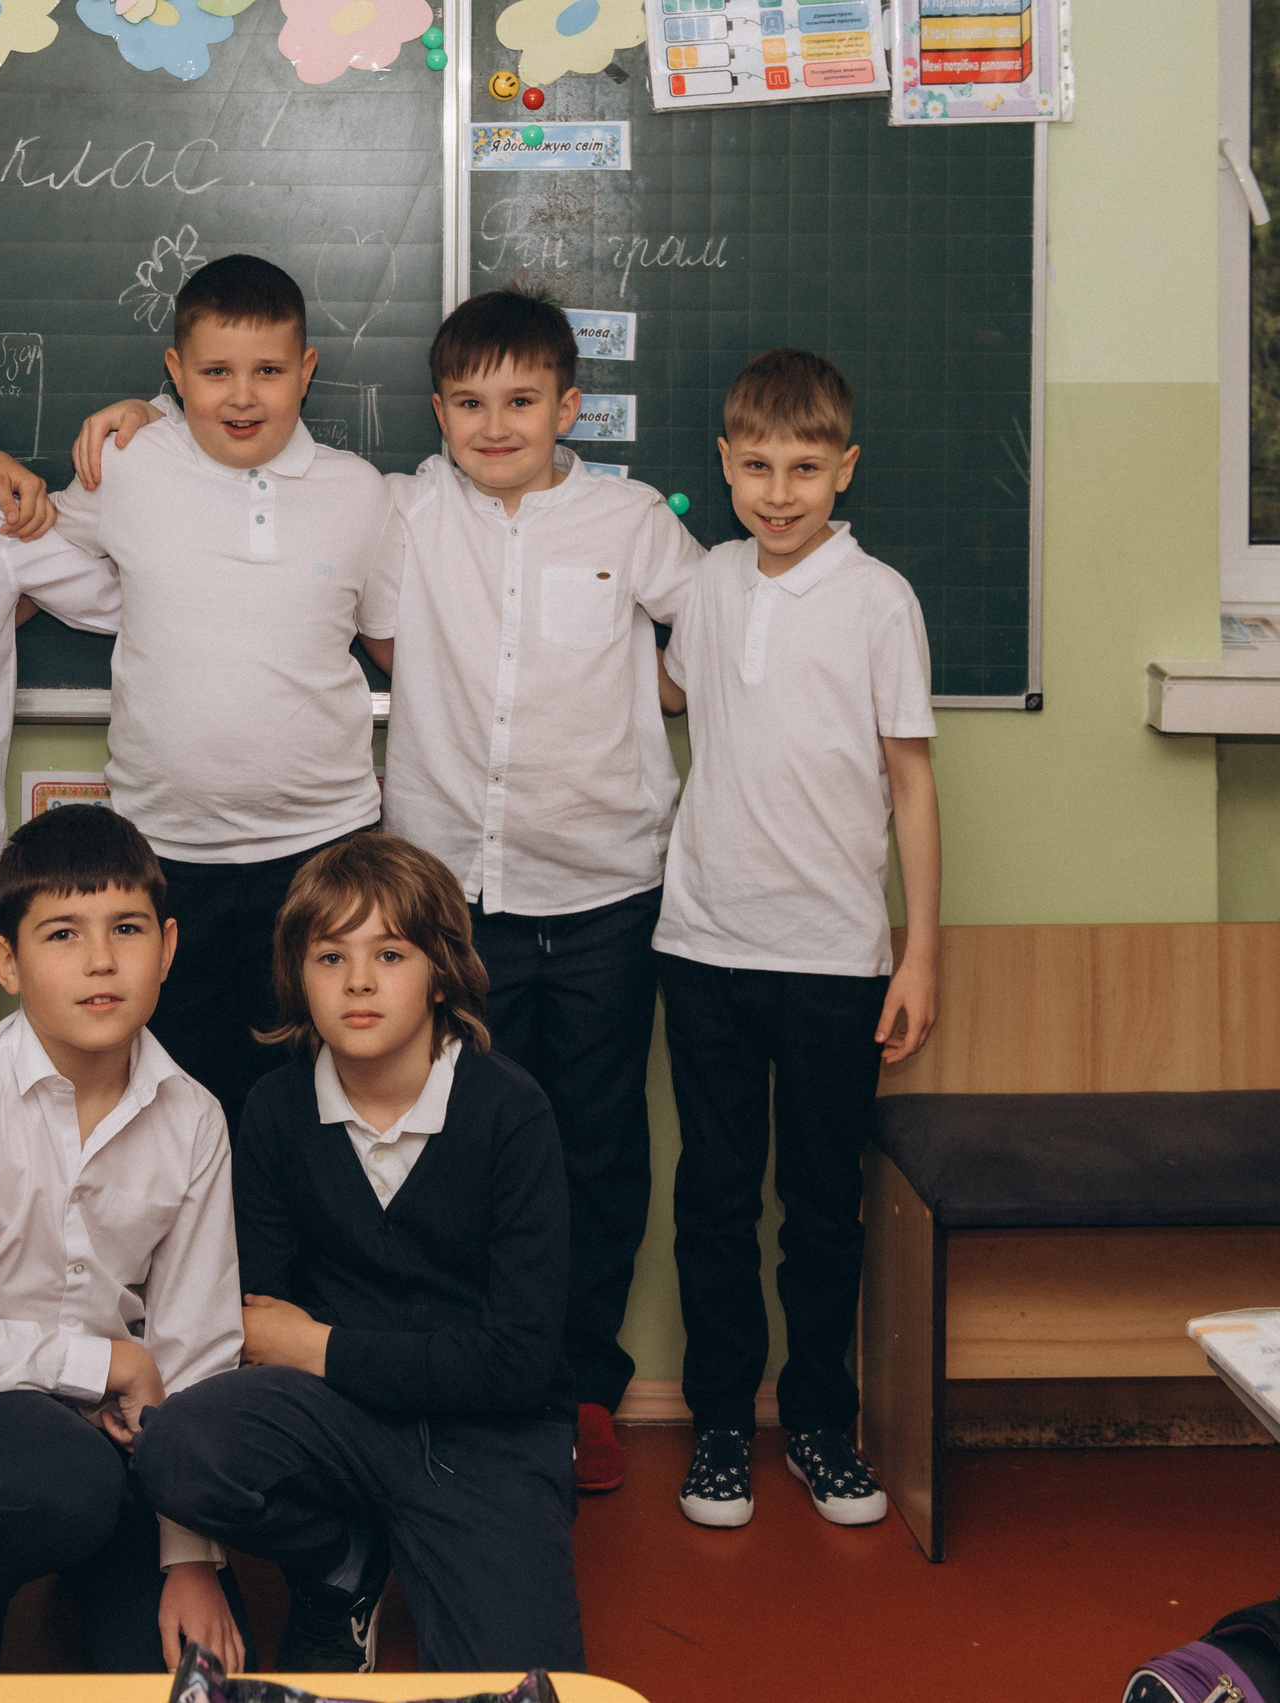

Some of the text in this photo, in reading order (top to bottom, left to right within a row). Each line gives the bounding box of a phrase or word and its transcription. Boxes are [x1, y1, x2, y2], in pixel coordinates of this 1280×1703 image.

[922, 59, 942, 72] Мені
[944, 58, 979, 74] потрібна
[491, 140, 500, 152] Я
[575, 138, 603, 151] світ
[577, 327, 611, 339] мова
[576, 411, 610, 422] мова
